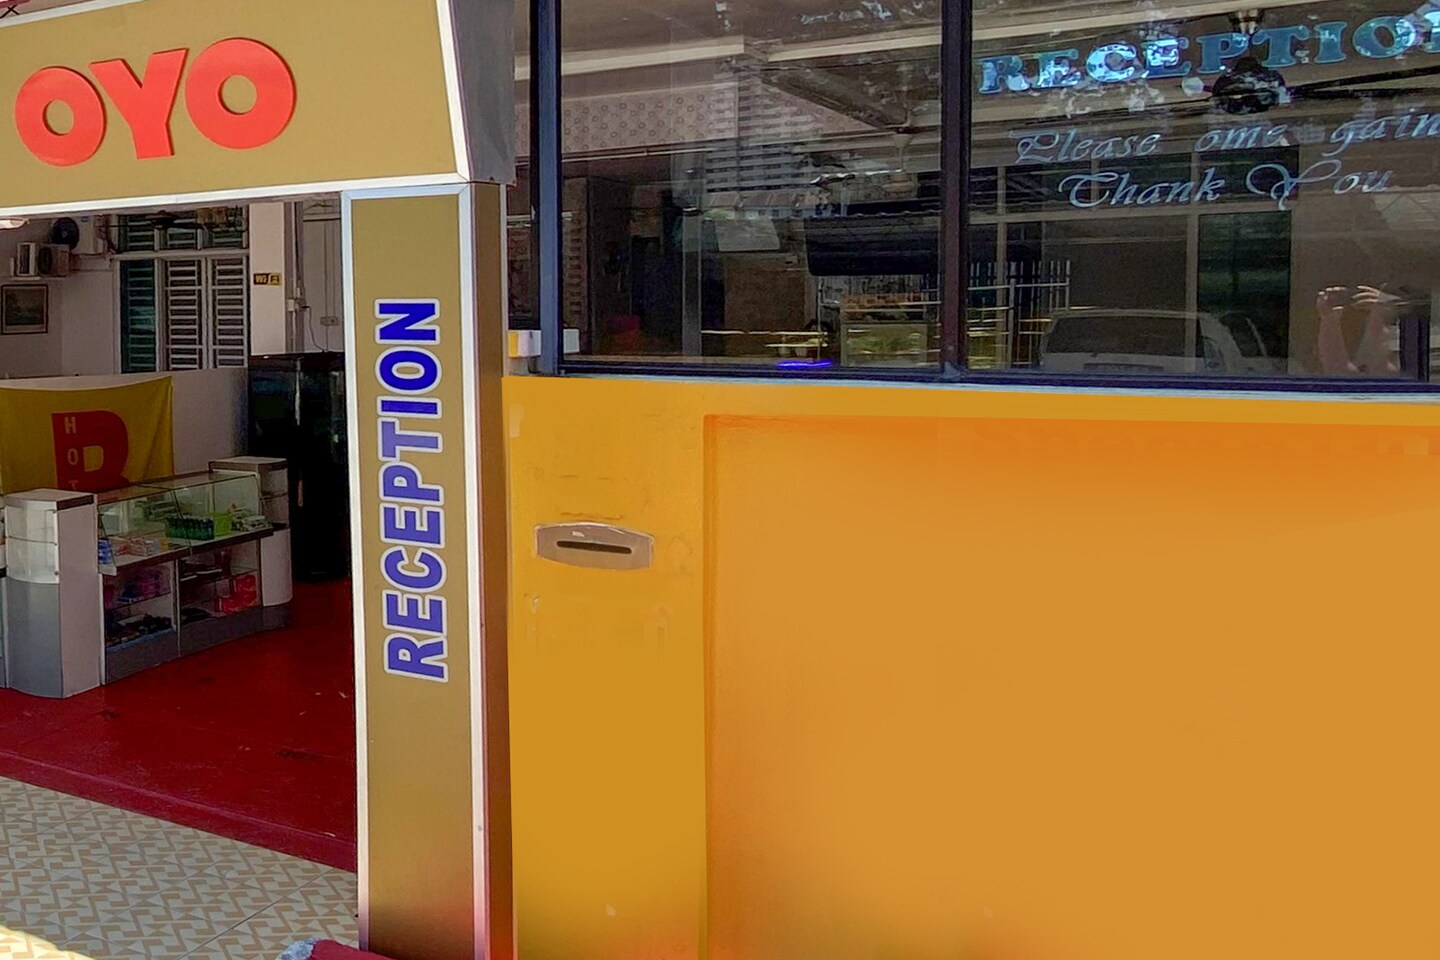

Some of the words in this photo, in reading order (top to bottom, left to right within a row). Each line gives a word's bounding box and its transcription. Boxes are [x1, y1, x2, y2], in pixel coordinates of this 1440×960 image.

[15, 37, 297, 168] OYO
[1010, 128, 1160, 164] Please
[1059, 167, 1225, 208] Thank
[1246, 159, 1392, 211] You
[375, 298, 448, 683] RECEPTION
